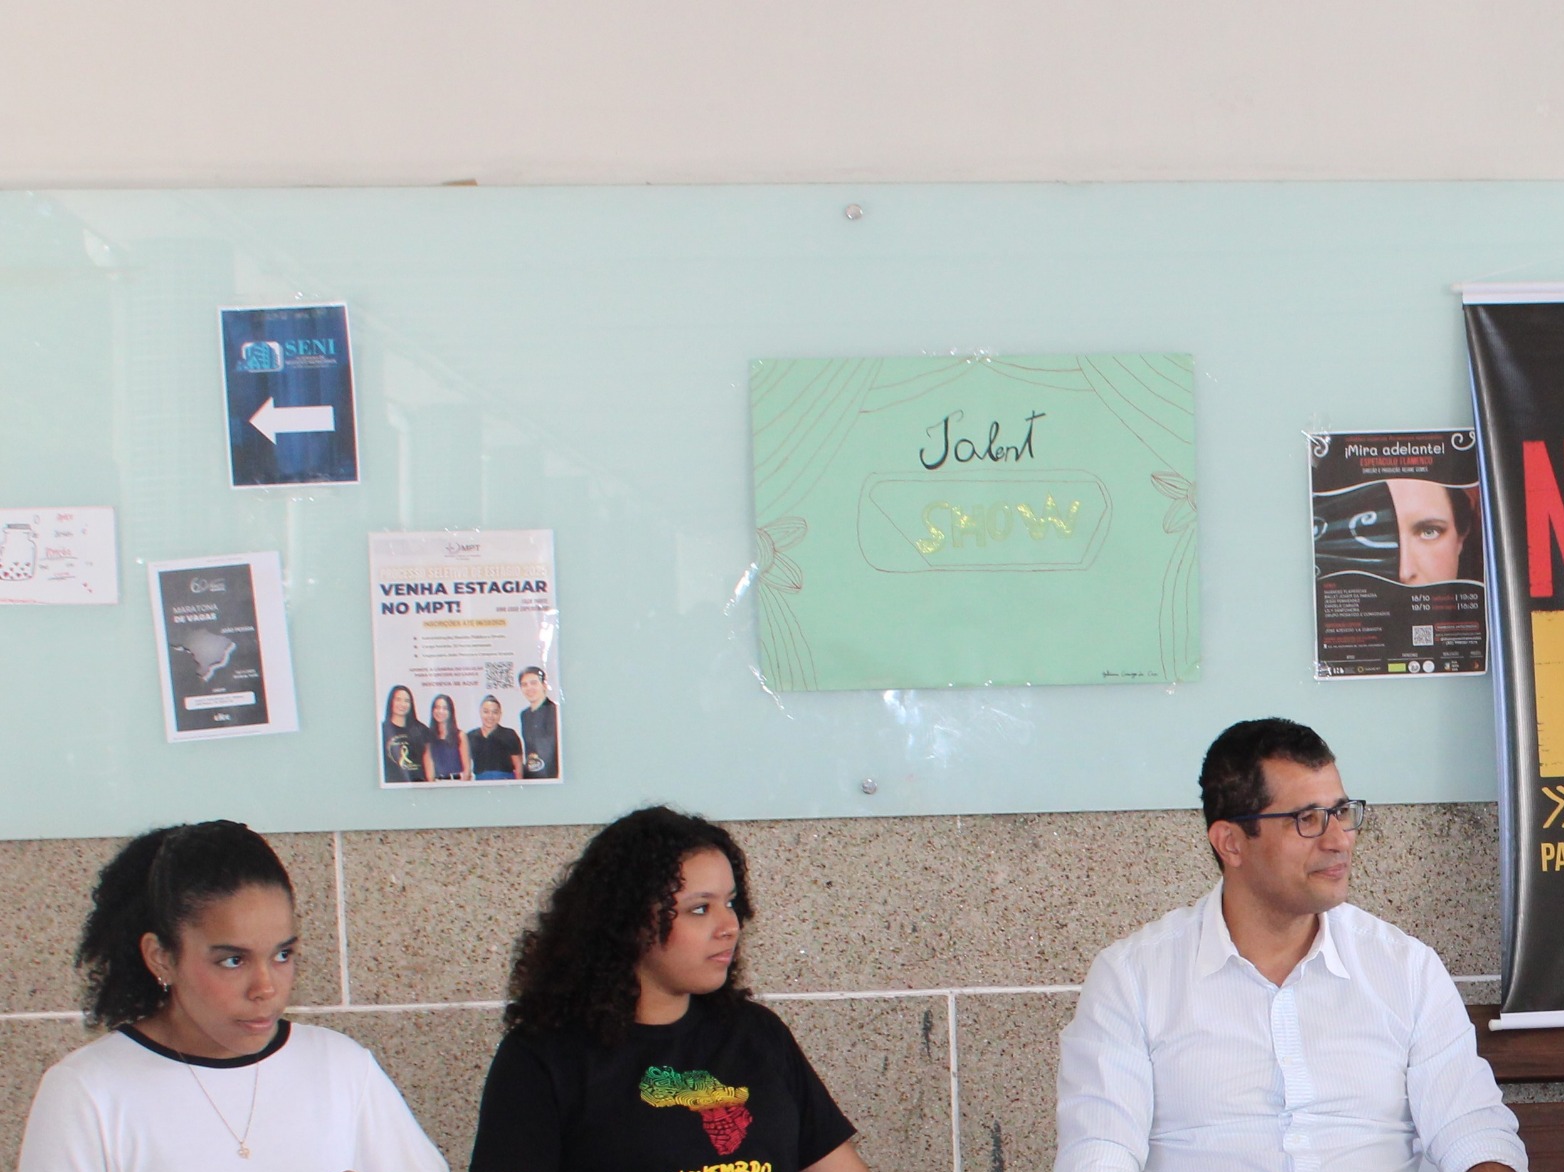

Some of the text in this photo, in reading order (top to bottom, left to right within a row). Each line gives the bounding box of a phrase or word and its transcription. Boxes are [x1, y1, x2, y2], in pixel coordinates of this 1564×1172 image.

[284, 338, 336, 356] SENI
[916, 492, 1081, 556] SHOW
[380, 580, 548, 596] VENHA ESTAGIAR
[172, 602, 219, 614] MARATONA
[381, 600, 461, 615] NO MPT!
[173, 612, 217, 624] DE VAGAS
